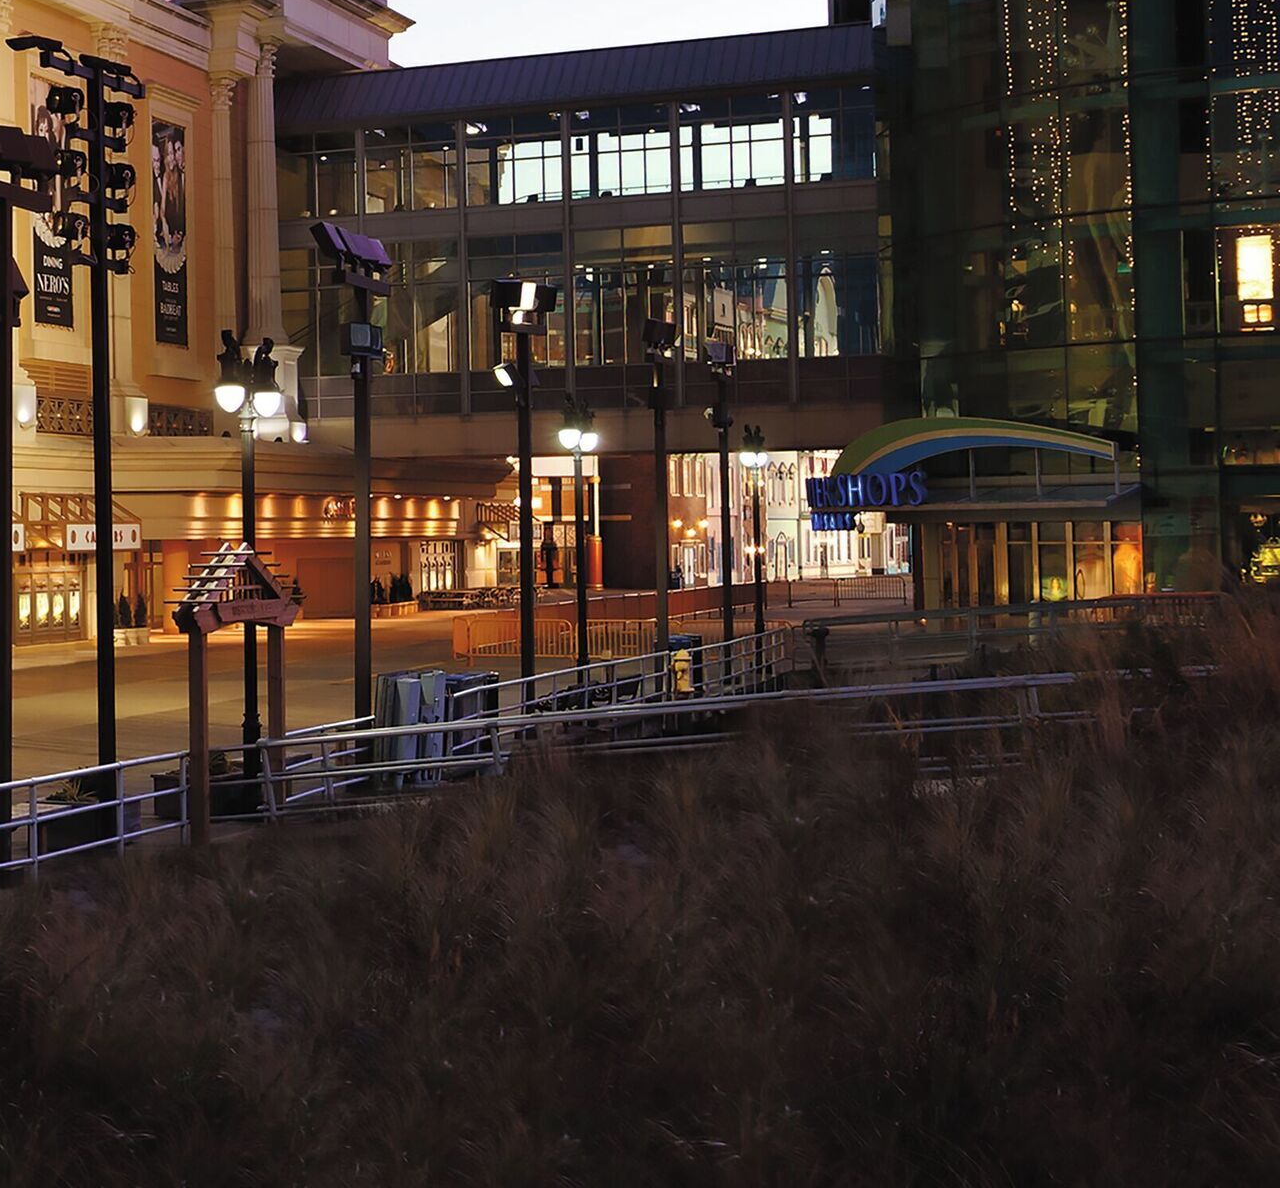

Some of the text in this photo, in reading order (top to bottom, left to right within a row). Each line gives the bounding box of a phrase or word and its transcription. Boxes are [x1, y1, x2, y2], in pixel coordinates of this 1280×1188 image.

[36, 272, 70, 295] NERO'S
[836, 470, 929, 507] SHOPS
[85, 530, 124, 544] CARS
